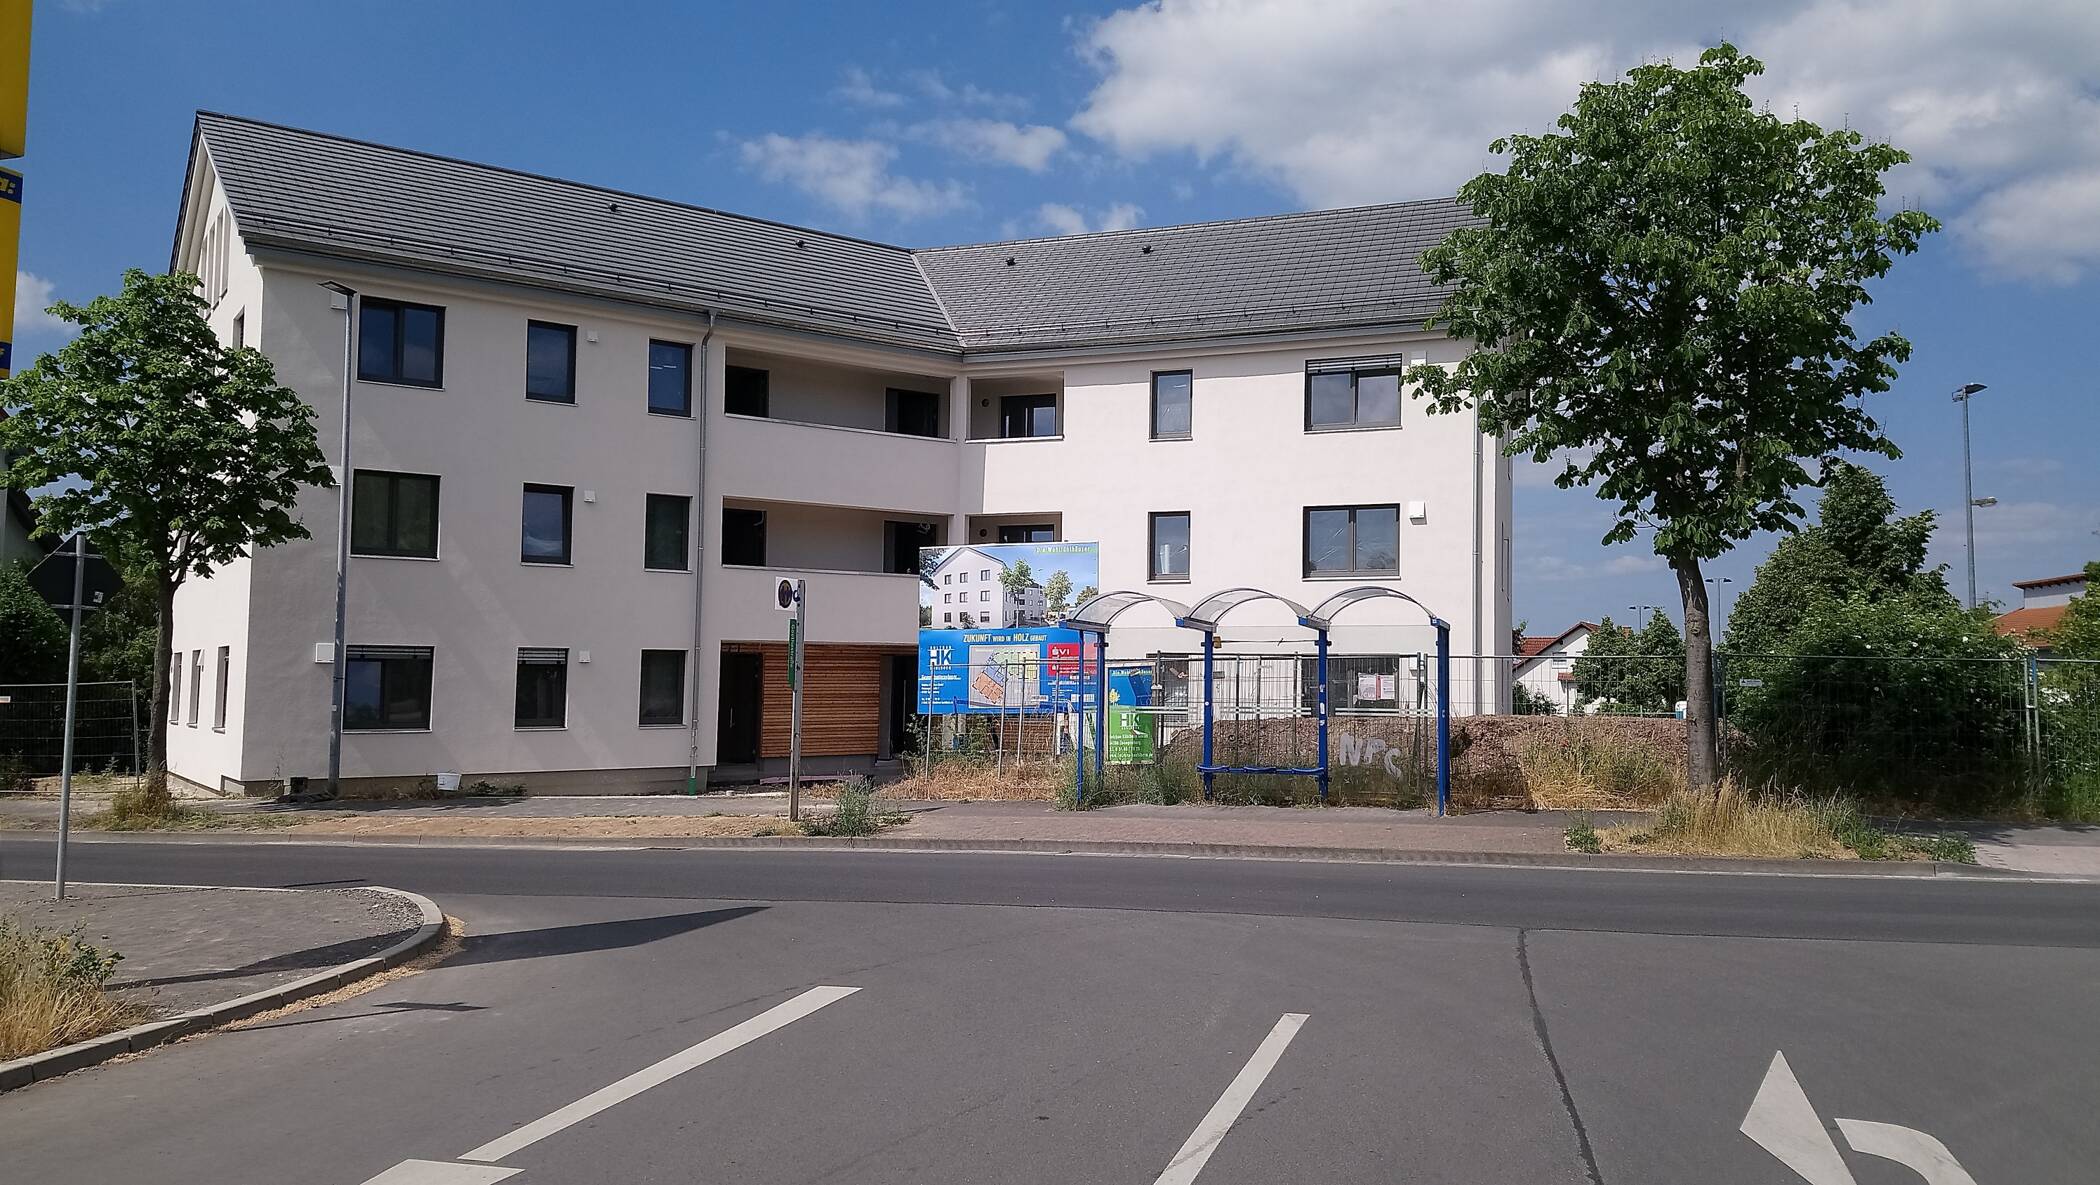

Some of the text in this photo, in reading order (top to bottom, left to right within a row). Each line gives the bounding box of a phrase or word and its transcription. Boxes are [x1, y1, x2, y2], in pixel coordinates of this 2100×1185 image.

[963, 633, 992, 642] ZUKUNFT
[1013, 632, 1029, 642] HOLZ
[1029, 634, 1048, 642] GEBAUT
